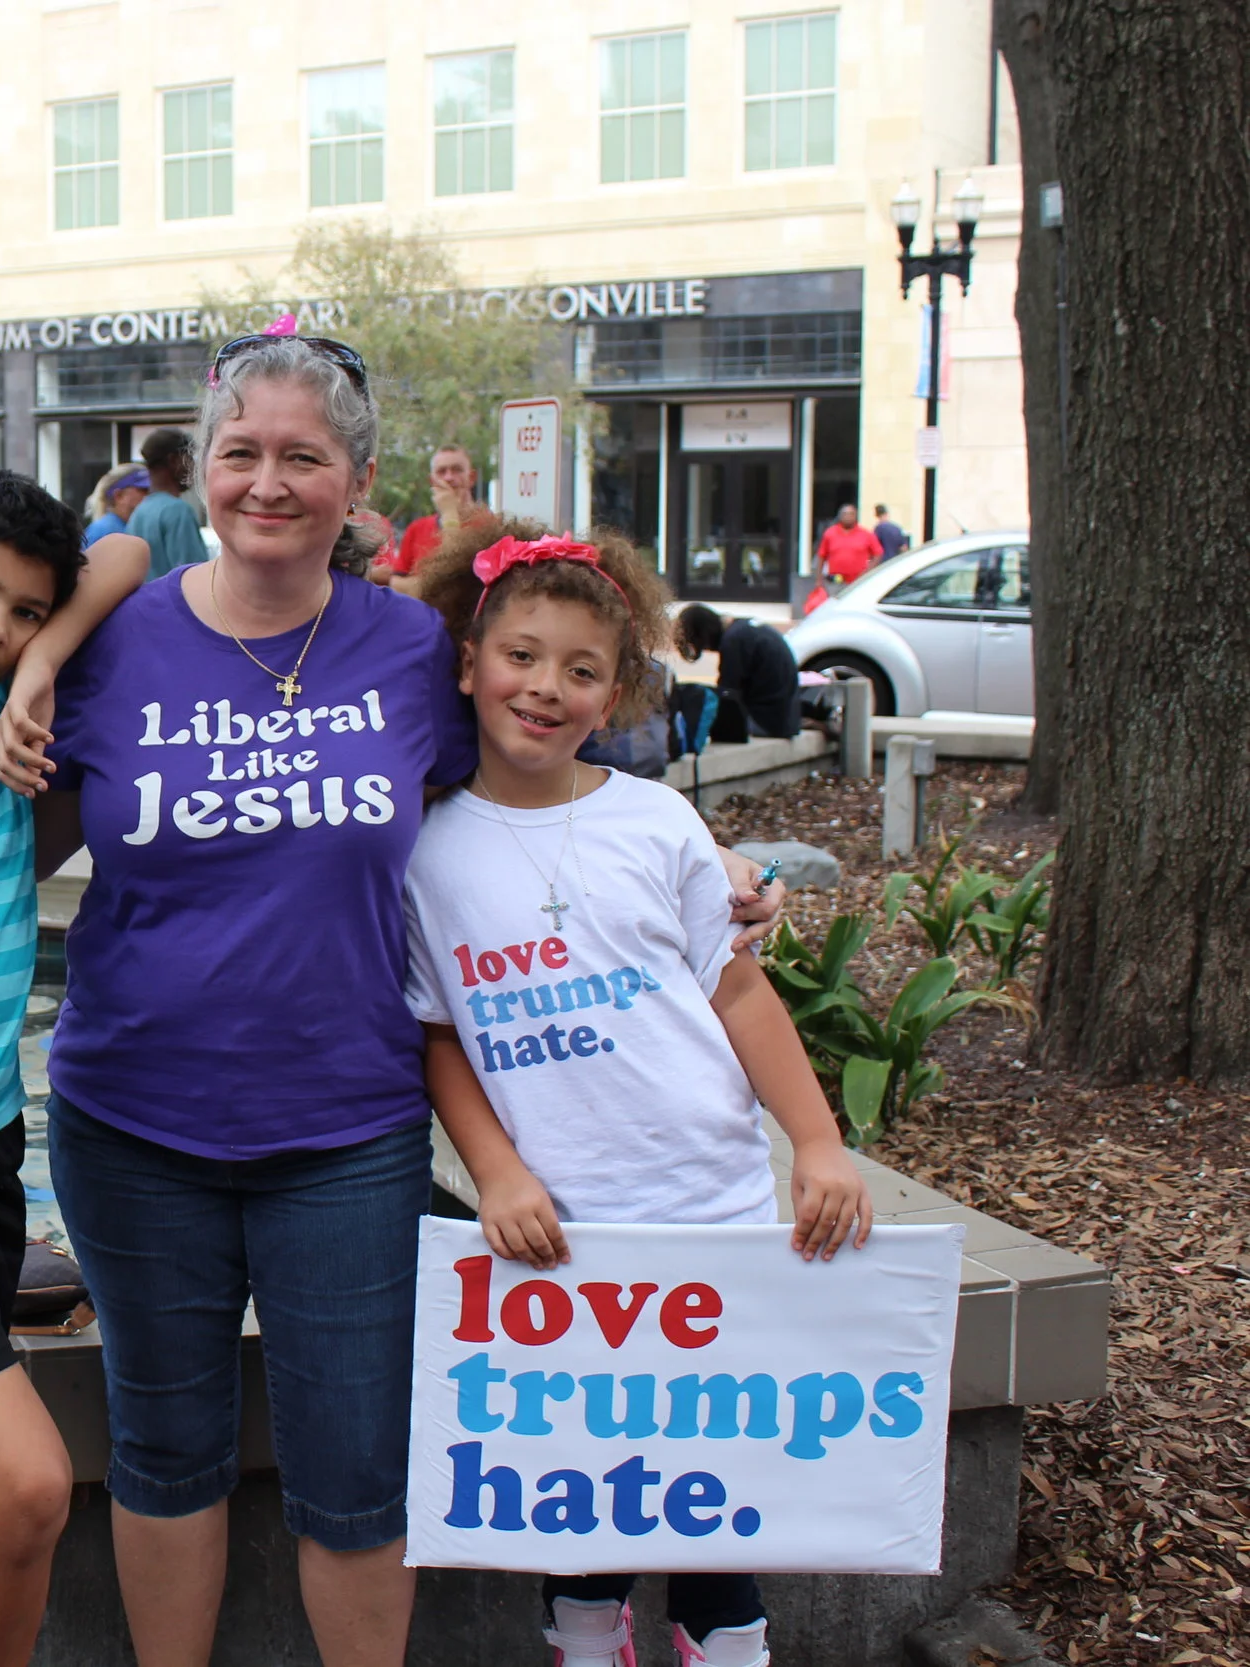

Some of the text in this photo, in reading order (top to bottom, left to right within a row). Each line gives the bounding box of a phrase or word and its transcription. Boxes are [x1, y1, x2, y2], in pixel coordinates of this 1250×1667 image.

[40, 318, 83, 349] OF
[517, 425, 542, 452] KEEP
[518, 471, 539, 497] OUT
[138, 689, 386, 746] Liberal
[207, 748, 319, 781] Like
[122, 771, 395, 845] Jesus
[453, 936, 569, 987] love
[475, 1023, 615, 1073] hate.
[452, 1254, 723, 1350] love
[447, 1352, 925, 1460] trumps
[443, 1441, 762, 1538] hate.
